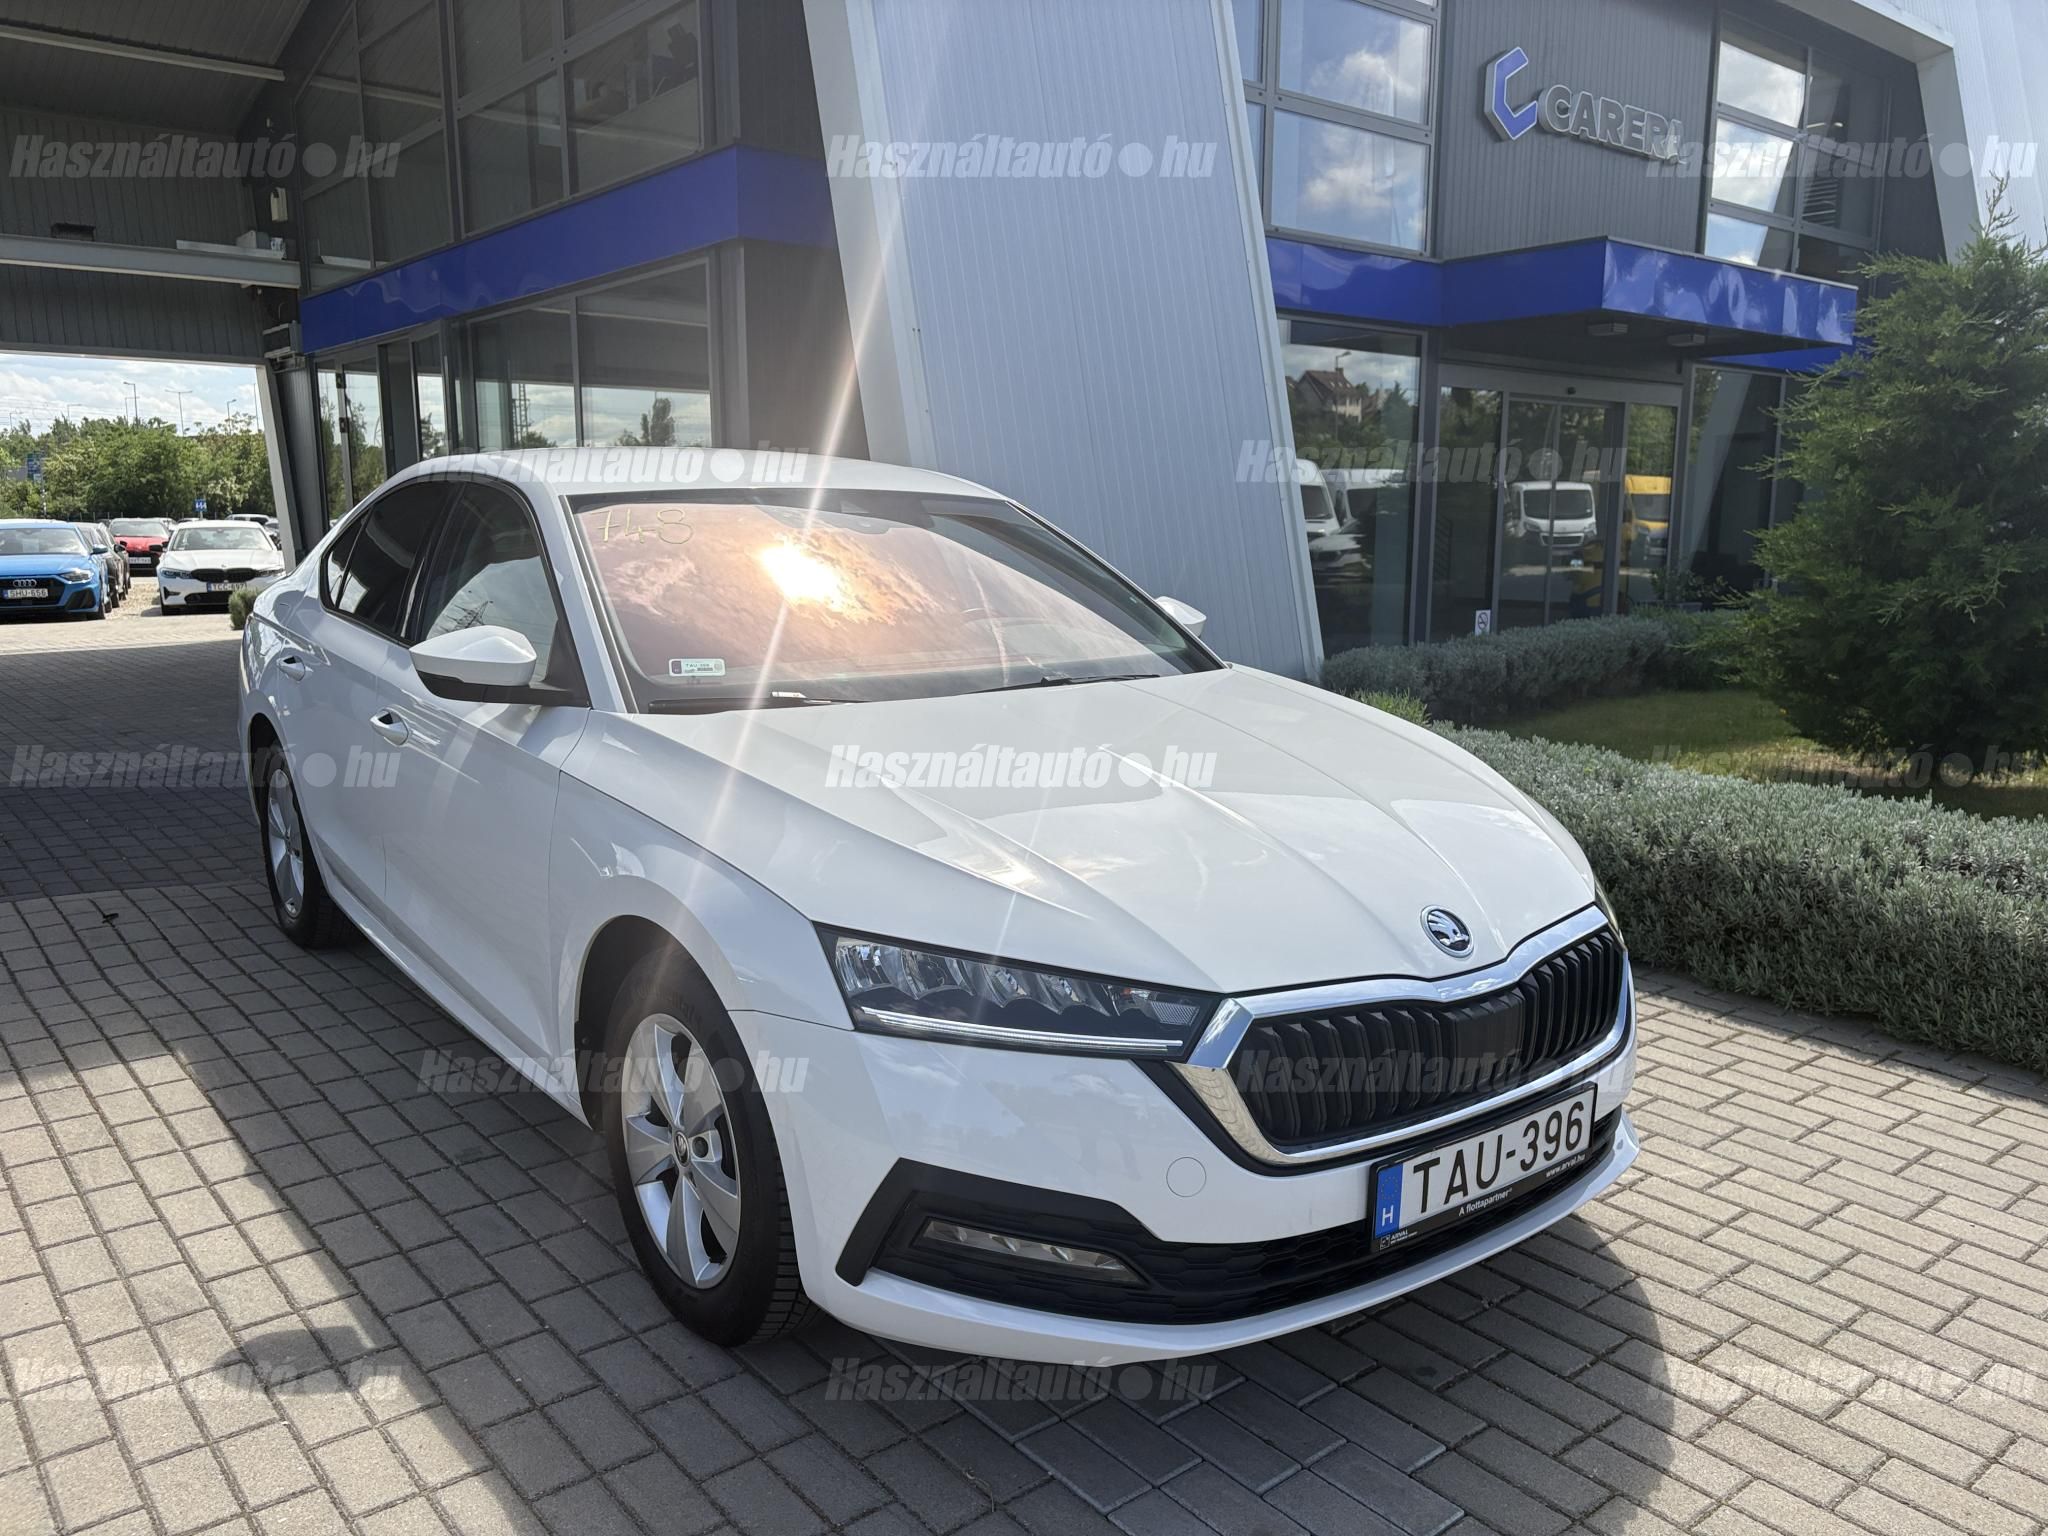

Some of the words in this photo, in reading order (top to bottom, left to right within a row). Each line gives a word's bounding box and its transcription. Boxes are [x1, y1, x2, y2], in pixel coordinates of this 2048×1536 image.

[590, 508, 695, 545] 748
[1413, 1101, 1584, 1215] TAU-396
[1381, 1204, 1394, 1227] H
